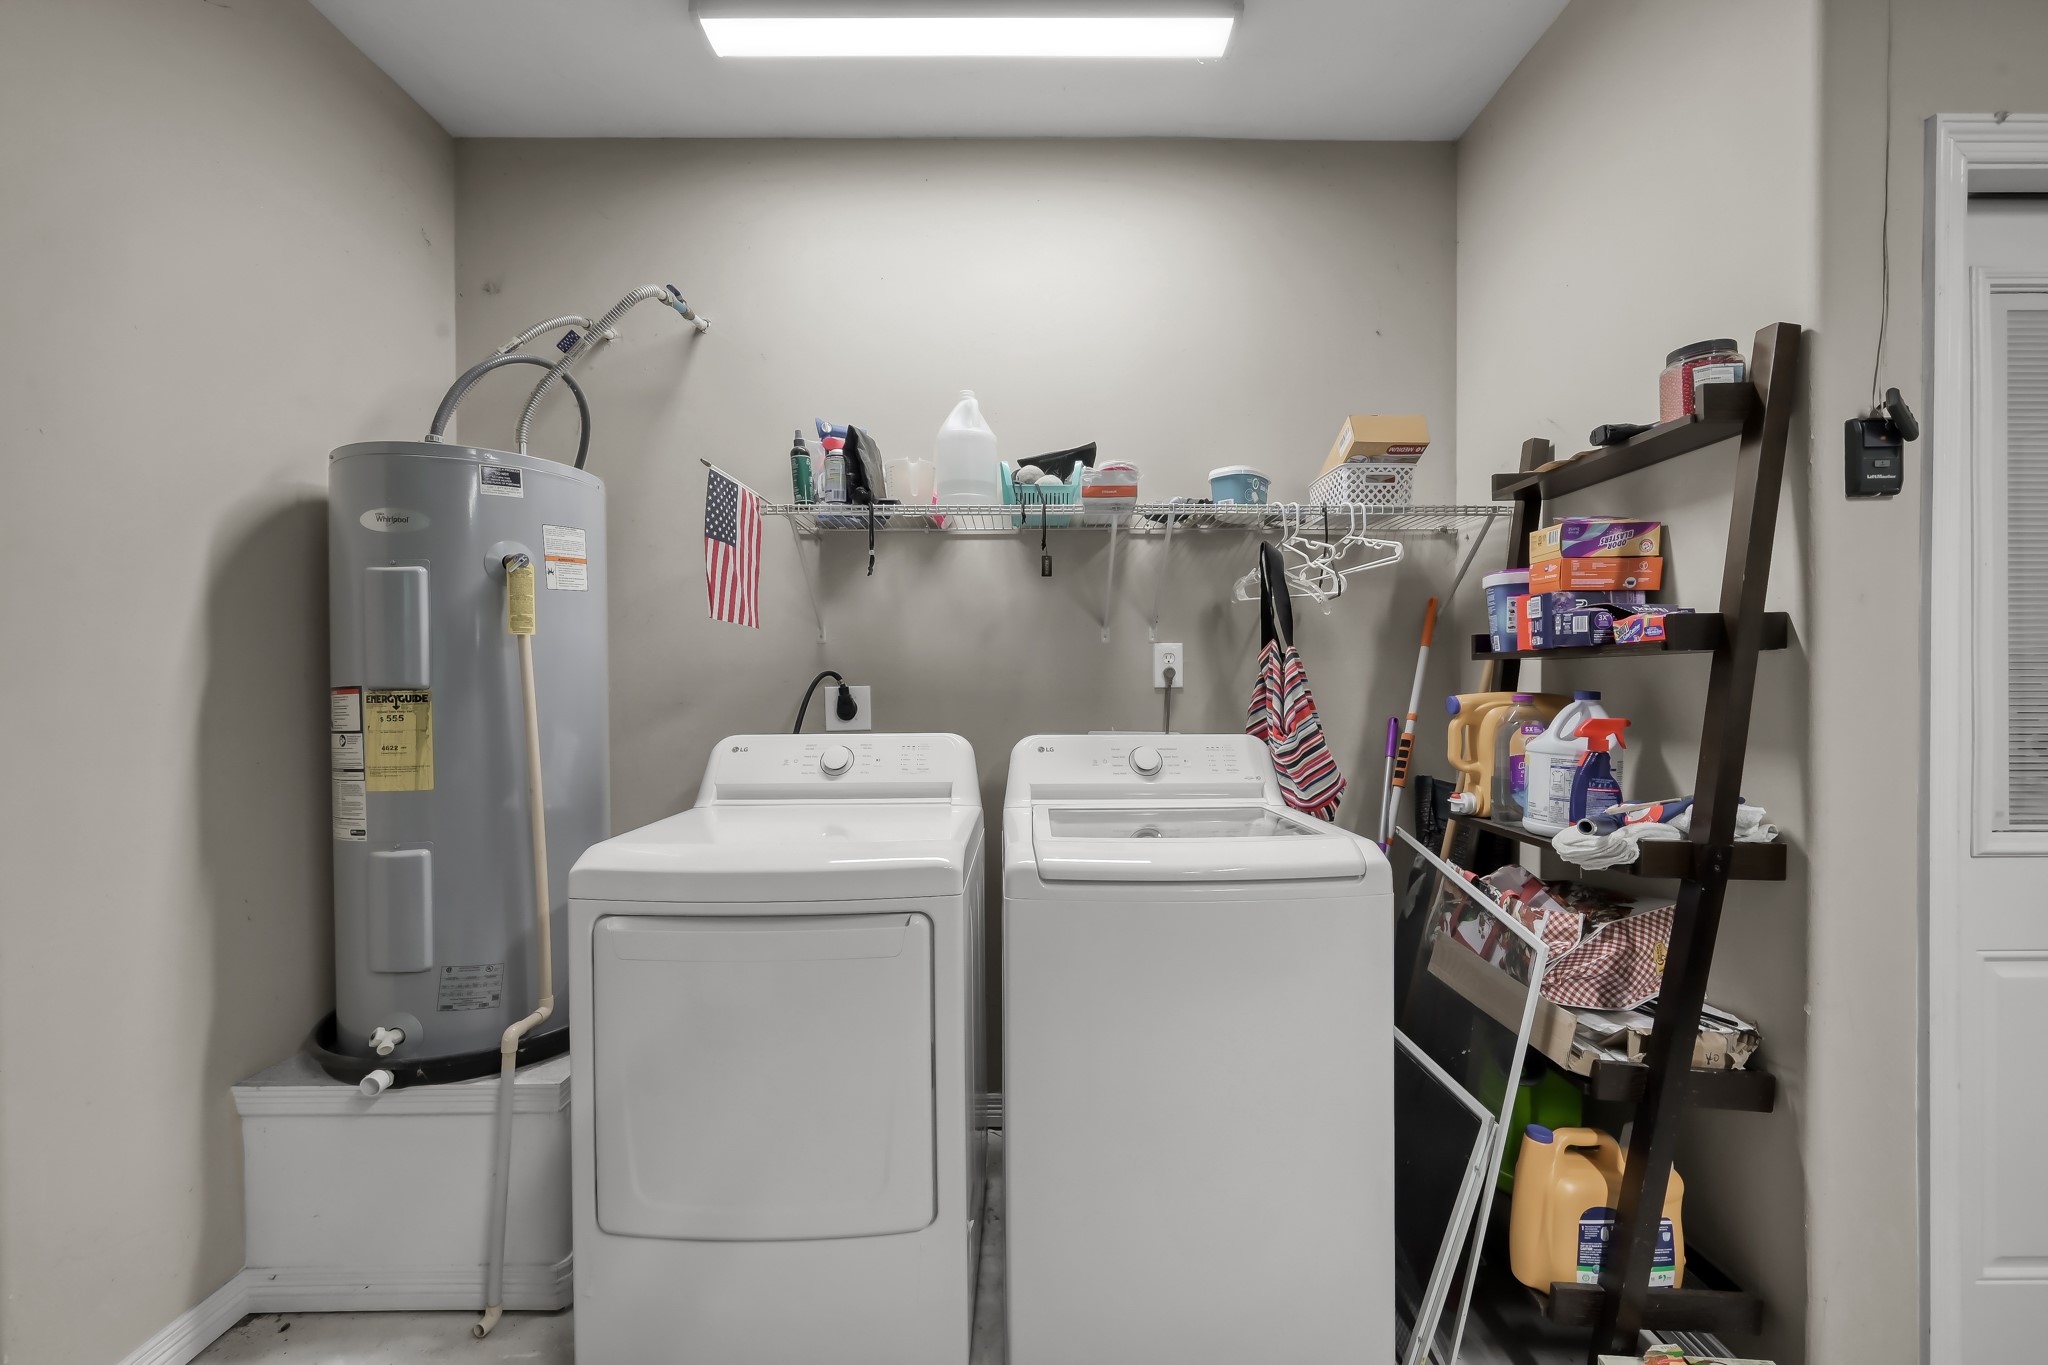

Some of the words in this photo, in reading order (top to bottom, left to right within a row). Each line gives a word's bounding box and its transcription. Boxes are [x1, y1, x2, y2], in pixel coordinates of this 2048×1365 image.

[375, 515, 409, 524] Whirlpool
[1599, 530, 1634, 545] BLASTERS
[1607, 539, 1627, 549] ODOR
[366, 694, 429, 705] ENERGYGUIDE
[386, 714, 405, 722] 555
